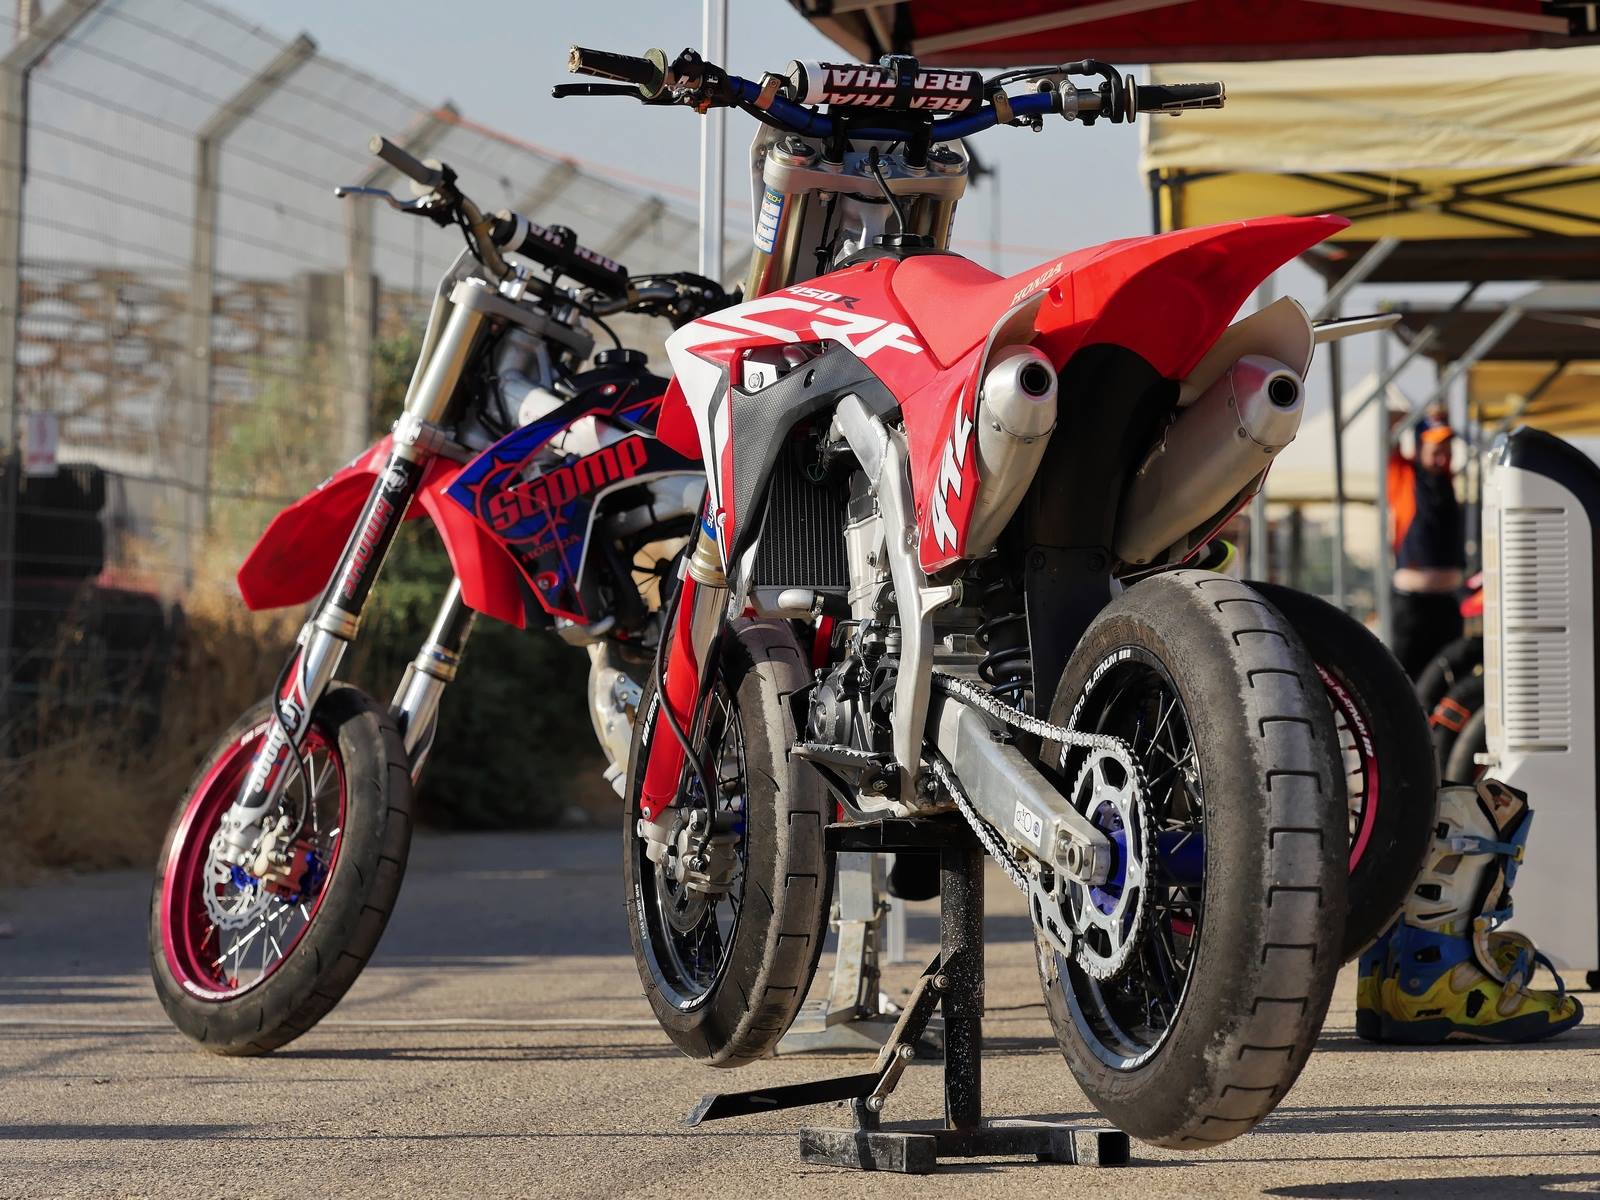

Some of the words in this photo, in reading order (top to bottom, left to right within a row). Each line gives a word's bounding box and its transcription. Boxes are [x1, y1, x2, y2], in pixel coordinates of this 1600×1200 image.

[822, 69, 972, 91] RENTHA
[824, 92, 973, 112] RENTHA
[784, 286, 861, 309] 450R
[1009, 261, 1063, 307] HONDA
[701, 296, 924, 359] CRF
[1084, 652, 1119, 696] PLATINUM
